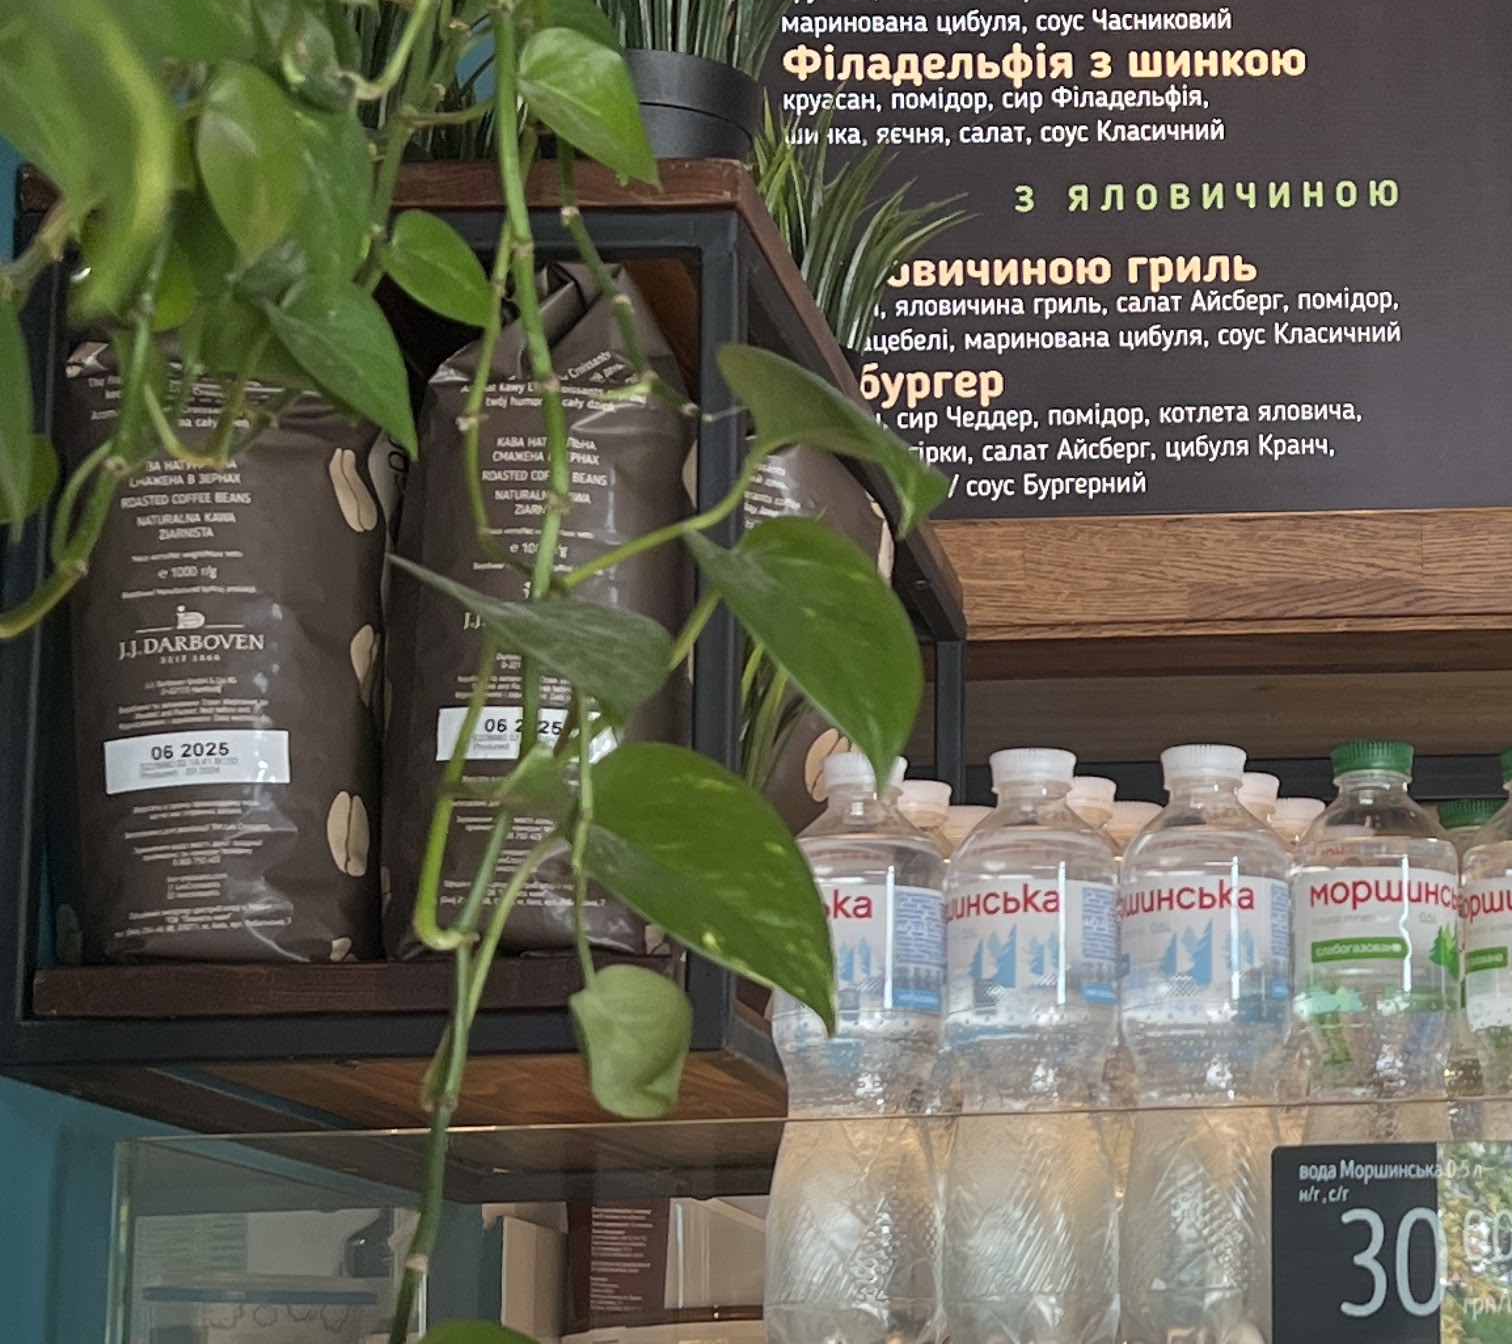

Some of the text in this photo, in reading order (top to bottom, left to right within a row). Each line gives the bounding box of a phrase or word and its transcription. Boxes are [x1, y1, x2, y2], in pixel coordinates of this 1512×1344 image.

[781, 7, 1232, 39] маринована цибуля, соус Часниковий
[782, 42, 1306, 91] Філадельфія з шинкою
[1014, 179, 1398, 213] З ЯЛОВИЧИНОЮ
[1127, 255, 1258, 292] гриль
[895, 286, 1401, 320] яловичина гриль, салат Айсберг, помідор,
[860, 362, 1005, 408] бургер
[484, 718, 563, 736] 06 225
[181, 742, 230, 759] 2025
[1299, 1163, 1336, 1182] вода
[1340, 1159, 1442, 1184] Моршинська
[1341, 1207, 1448, 1317] 30
